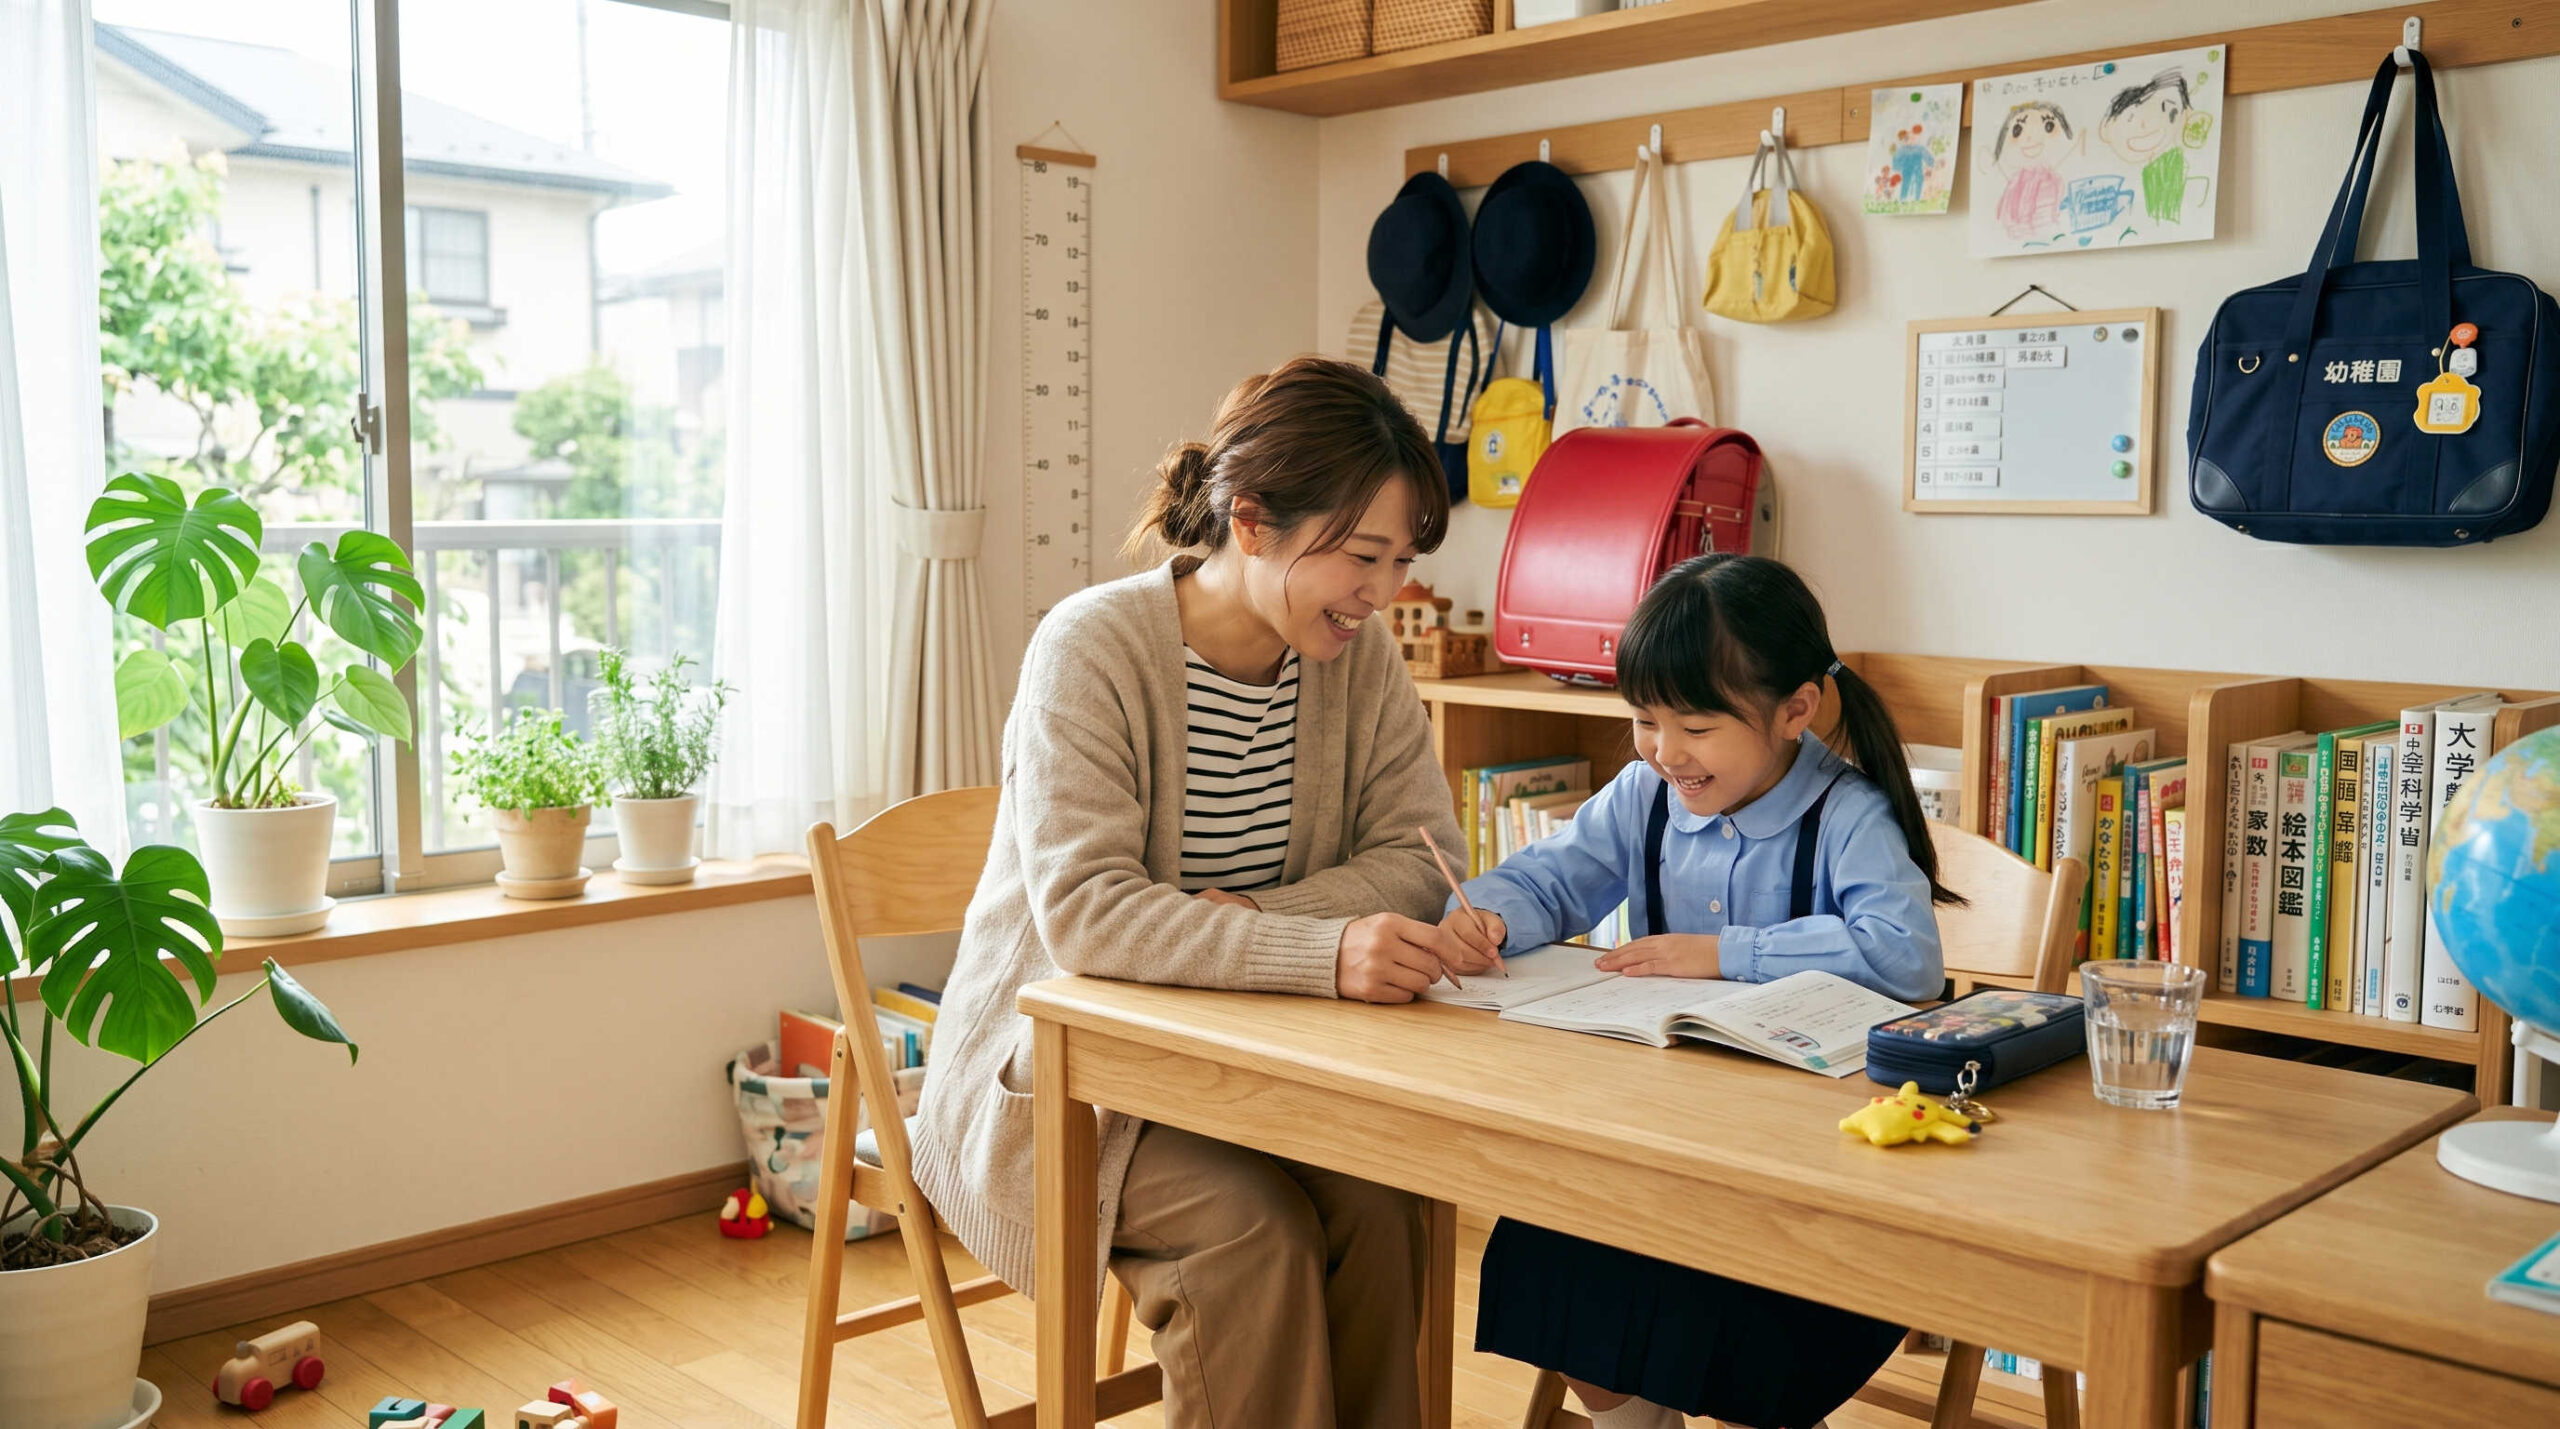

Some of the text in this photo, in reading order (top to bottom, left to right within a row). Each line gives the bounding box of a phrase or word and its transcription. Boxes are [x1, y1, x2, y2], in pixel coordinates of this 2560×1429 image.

[1035, 234, 1048, 246] 70
[1927, 354, 1935, 364] 1
[2323, 359, 2402, 384] 幼稚園
[1924, 376, 1934, 387] 2
[1923, 398, 1932, 409] 3
[1067, 420, 1078, 431] 11
[1922, 423, 1932, 433] 4
[1072, 558, 1079, 569] 7
[2246, 810, 2269, 857] 家数
[2278, 812, 2307, 917] 絵本図鑑
